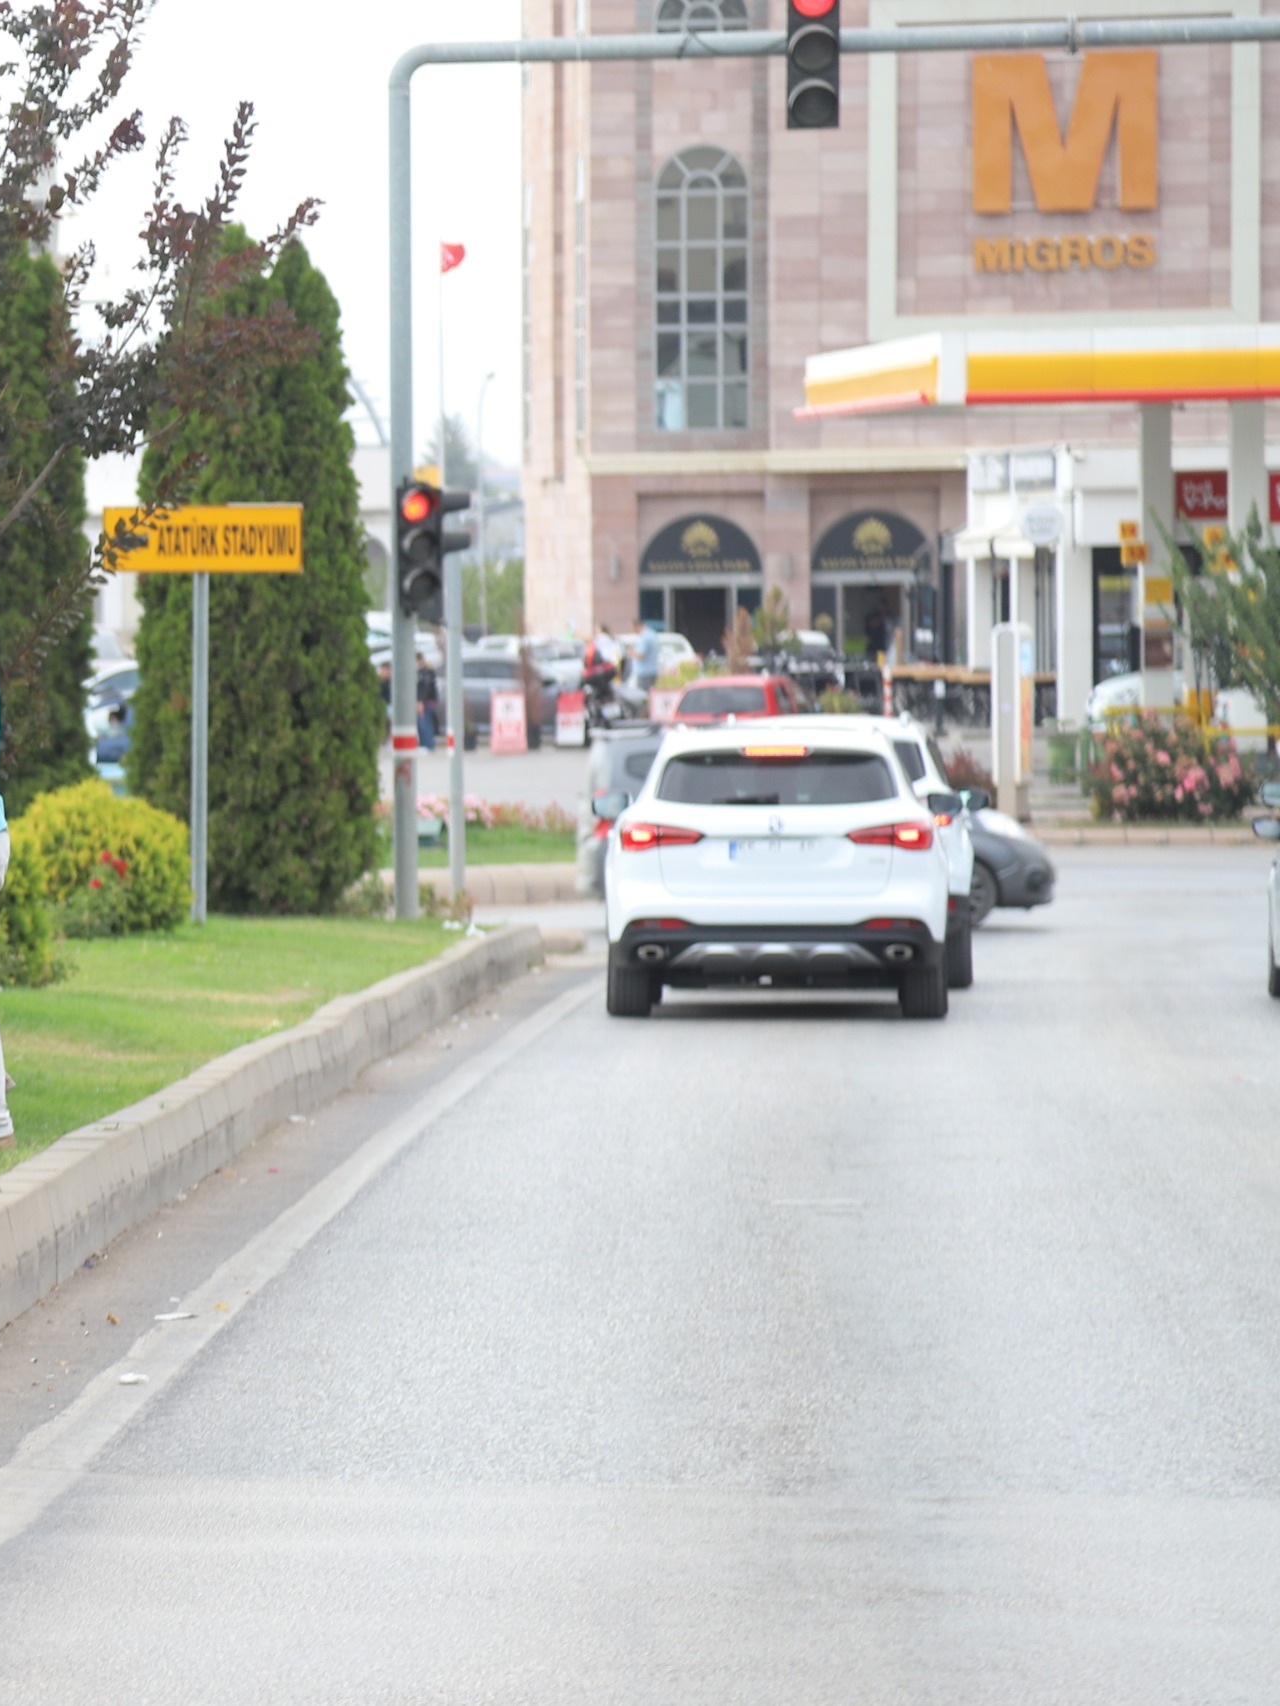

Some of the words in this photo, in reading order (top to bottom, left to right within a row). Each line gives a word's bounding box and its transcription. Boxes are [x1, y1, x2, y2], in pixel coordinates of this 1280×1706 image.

[973, 52, 1158, 215] M
[974, 234, 1158, 273] MIGROS
[157, 517, 219, 557] ATATÜRK
[223, 523, 297, 557] STADYUMU
